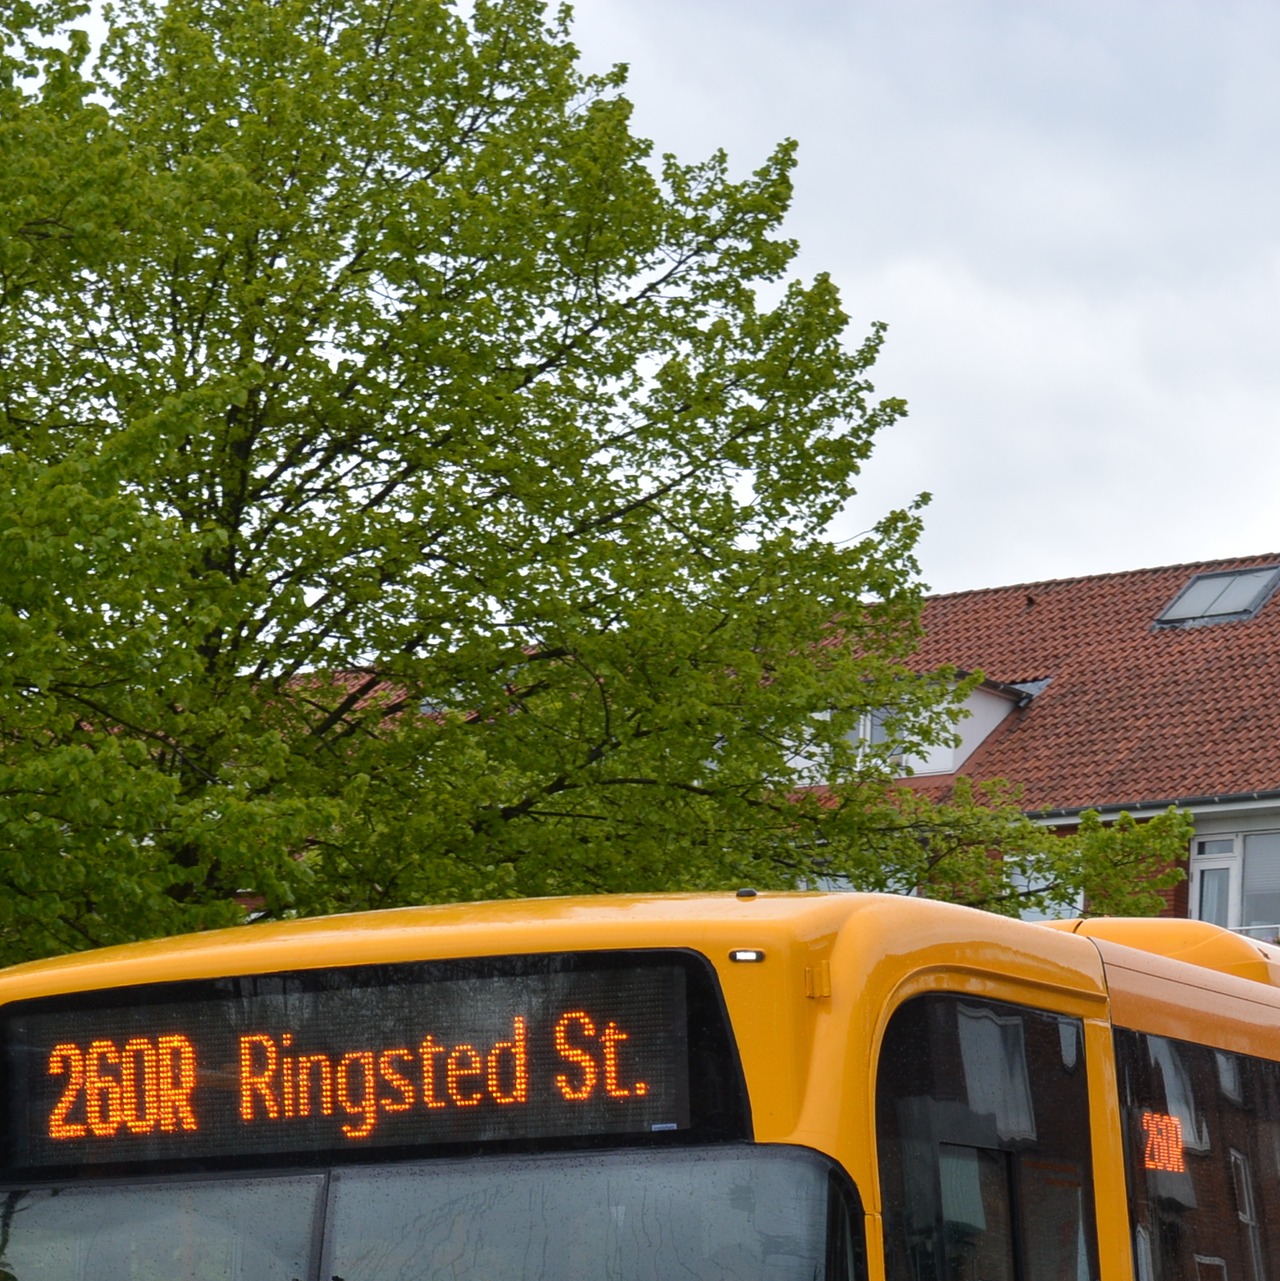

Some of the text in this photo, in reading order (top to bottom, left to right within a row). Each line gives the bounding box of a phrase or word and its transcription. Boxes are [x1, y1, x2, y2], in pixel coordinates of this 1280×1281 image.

[46, 1010, 649, 1141] 260R Ringsted St.
